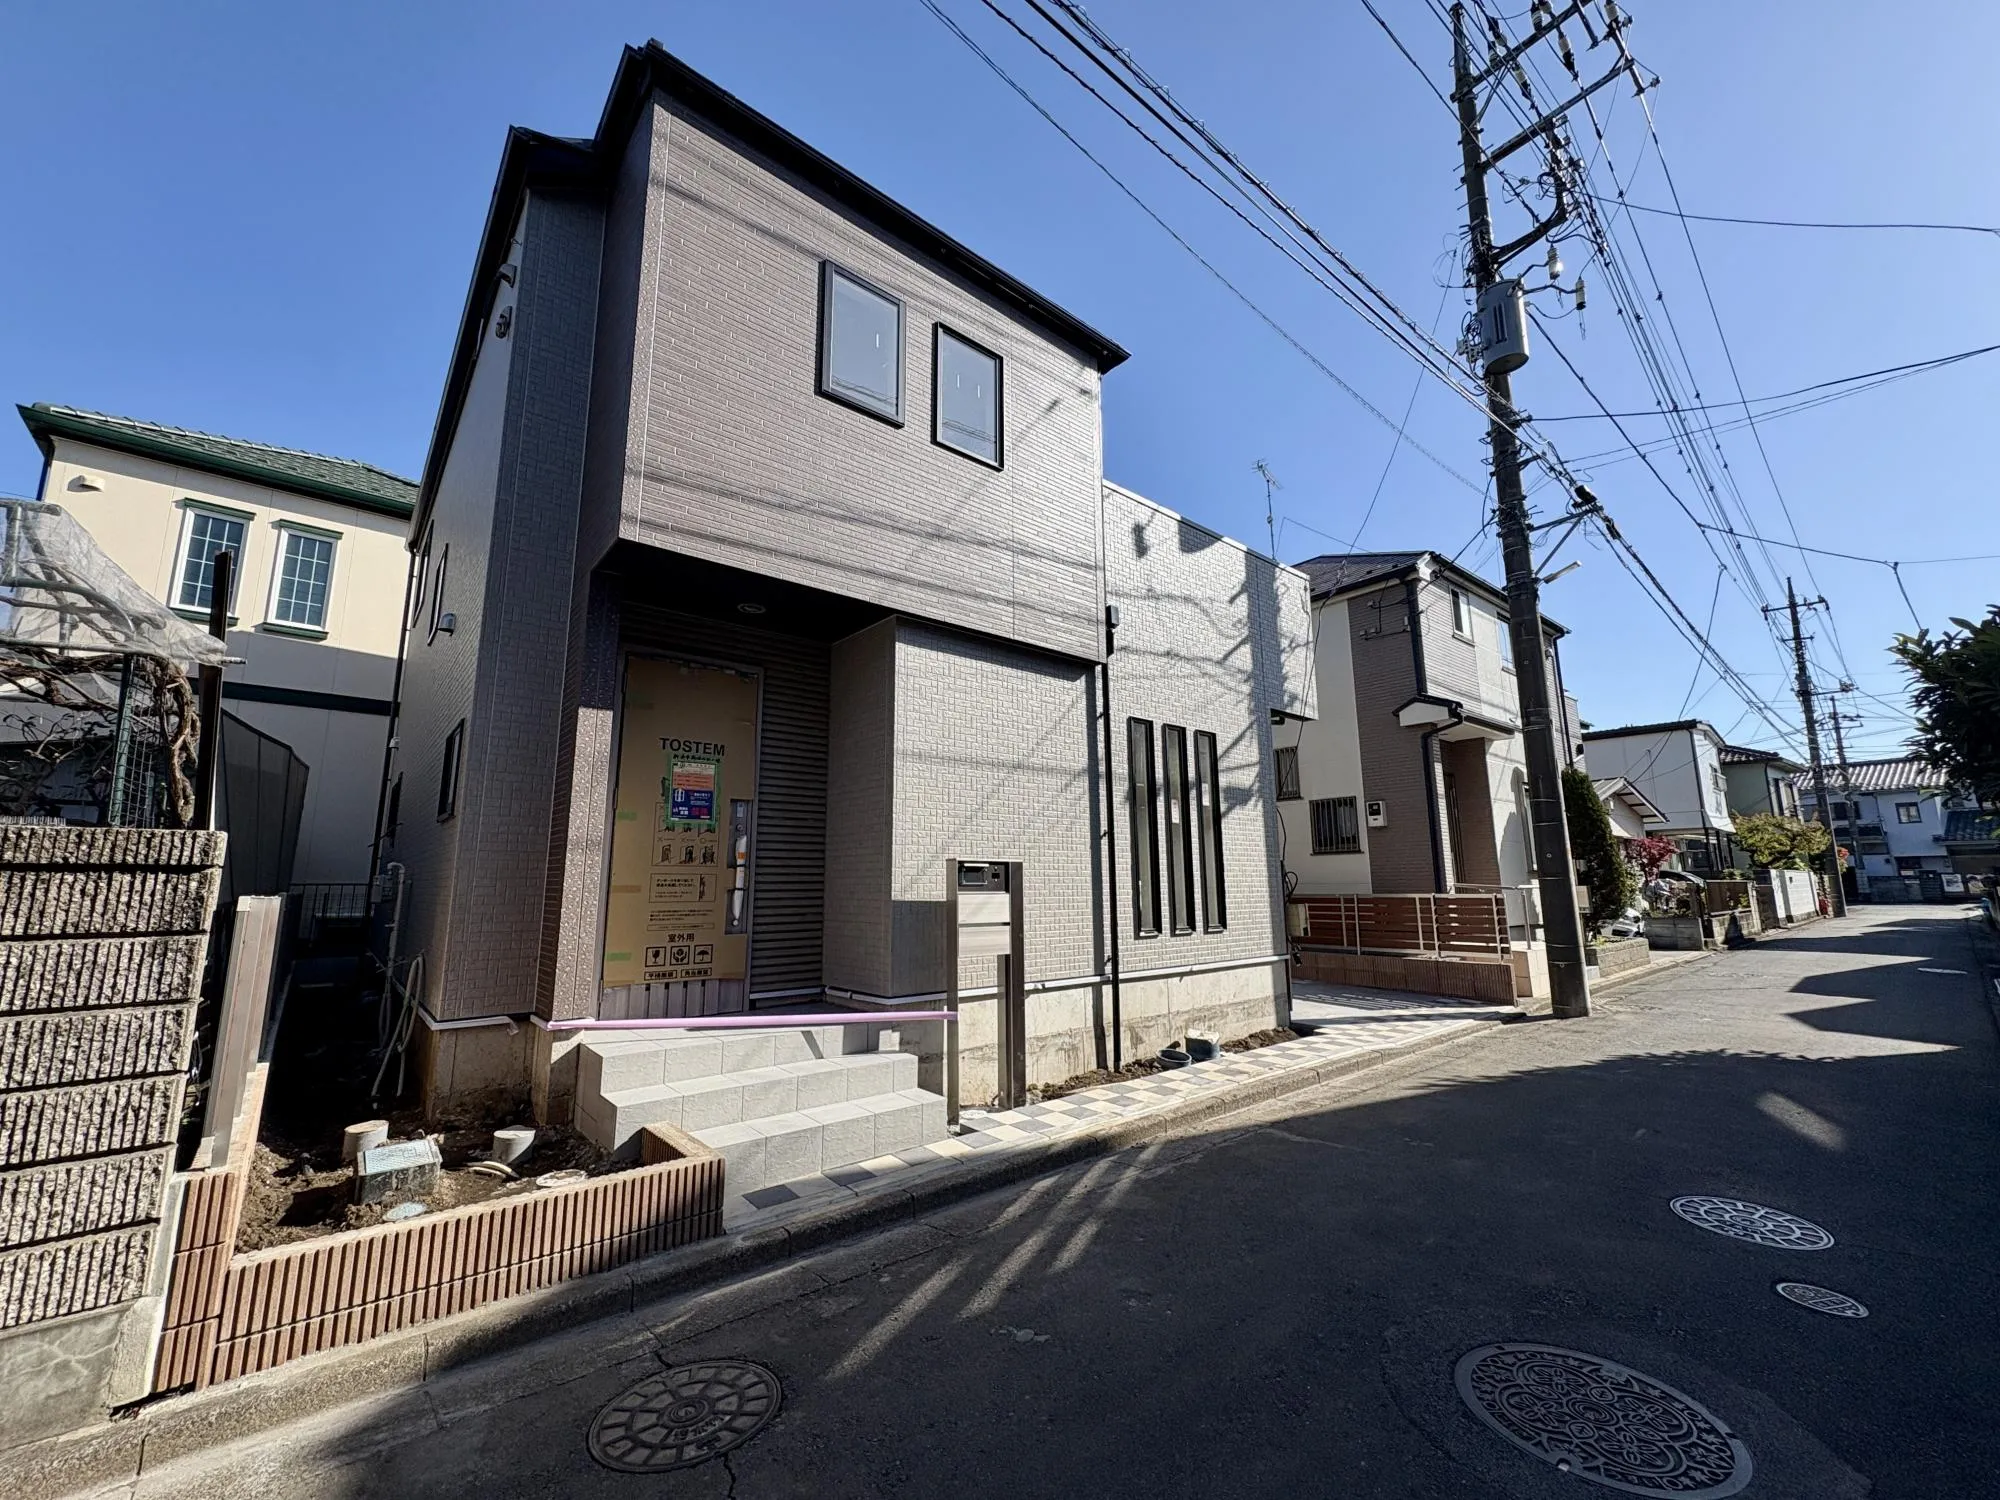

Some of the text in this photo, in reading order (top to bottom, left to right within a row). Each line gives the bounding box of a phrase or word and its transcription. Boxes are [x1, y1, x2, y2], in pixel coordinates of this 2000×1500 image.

[659, 737, 726, 757] TOSTEM
[667, 932, 695, 943] 室外用
